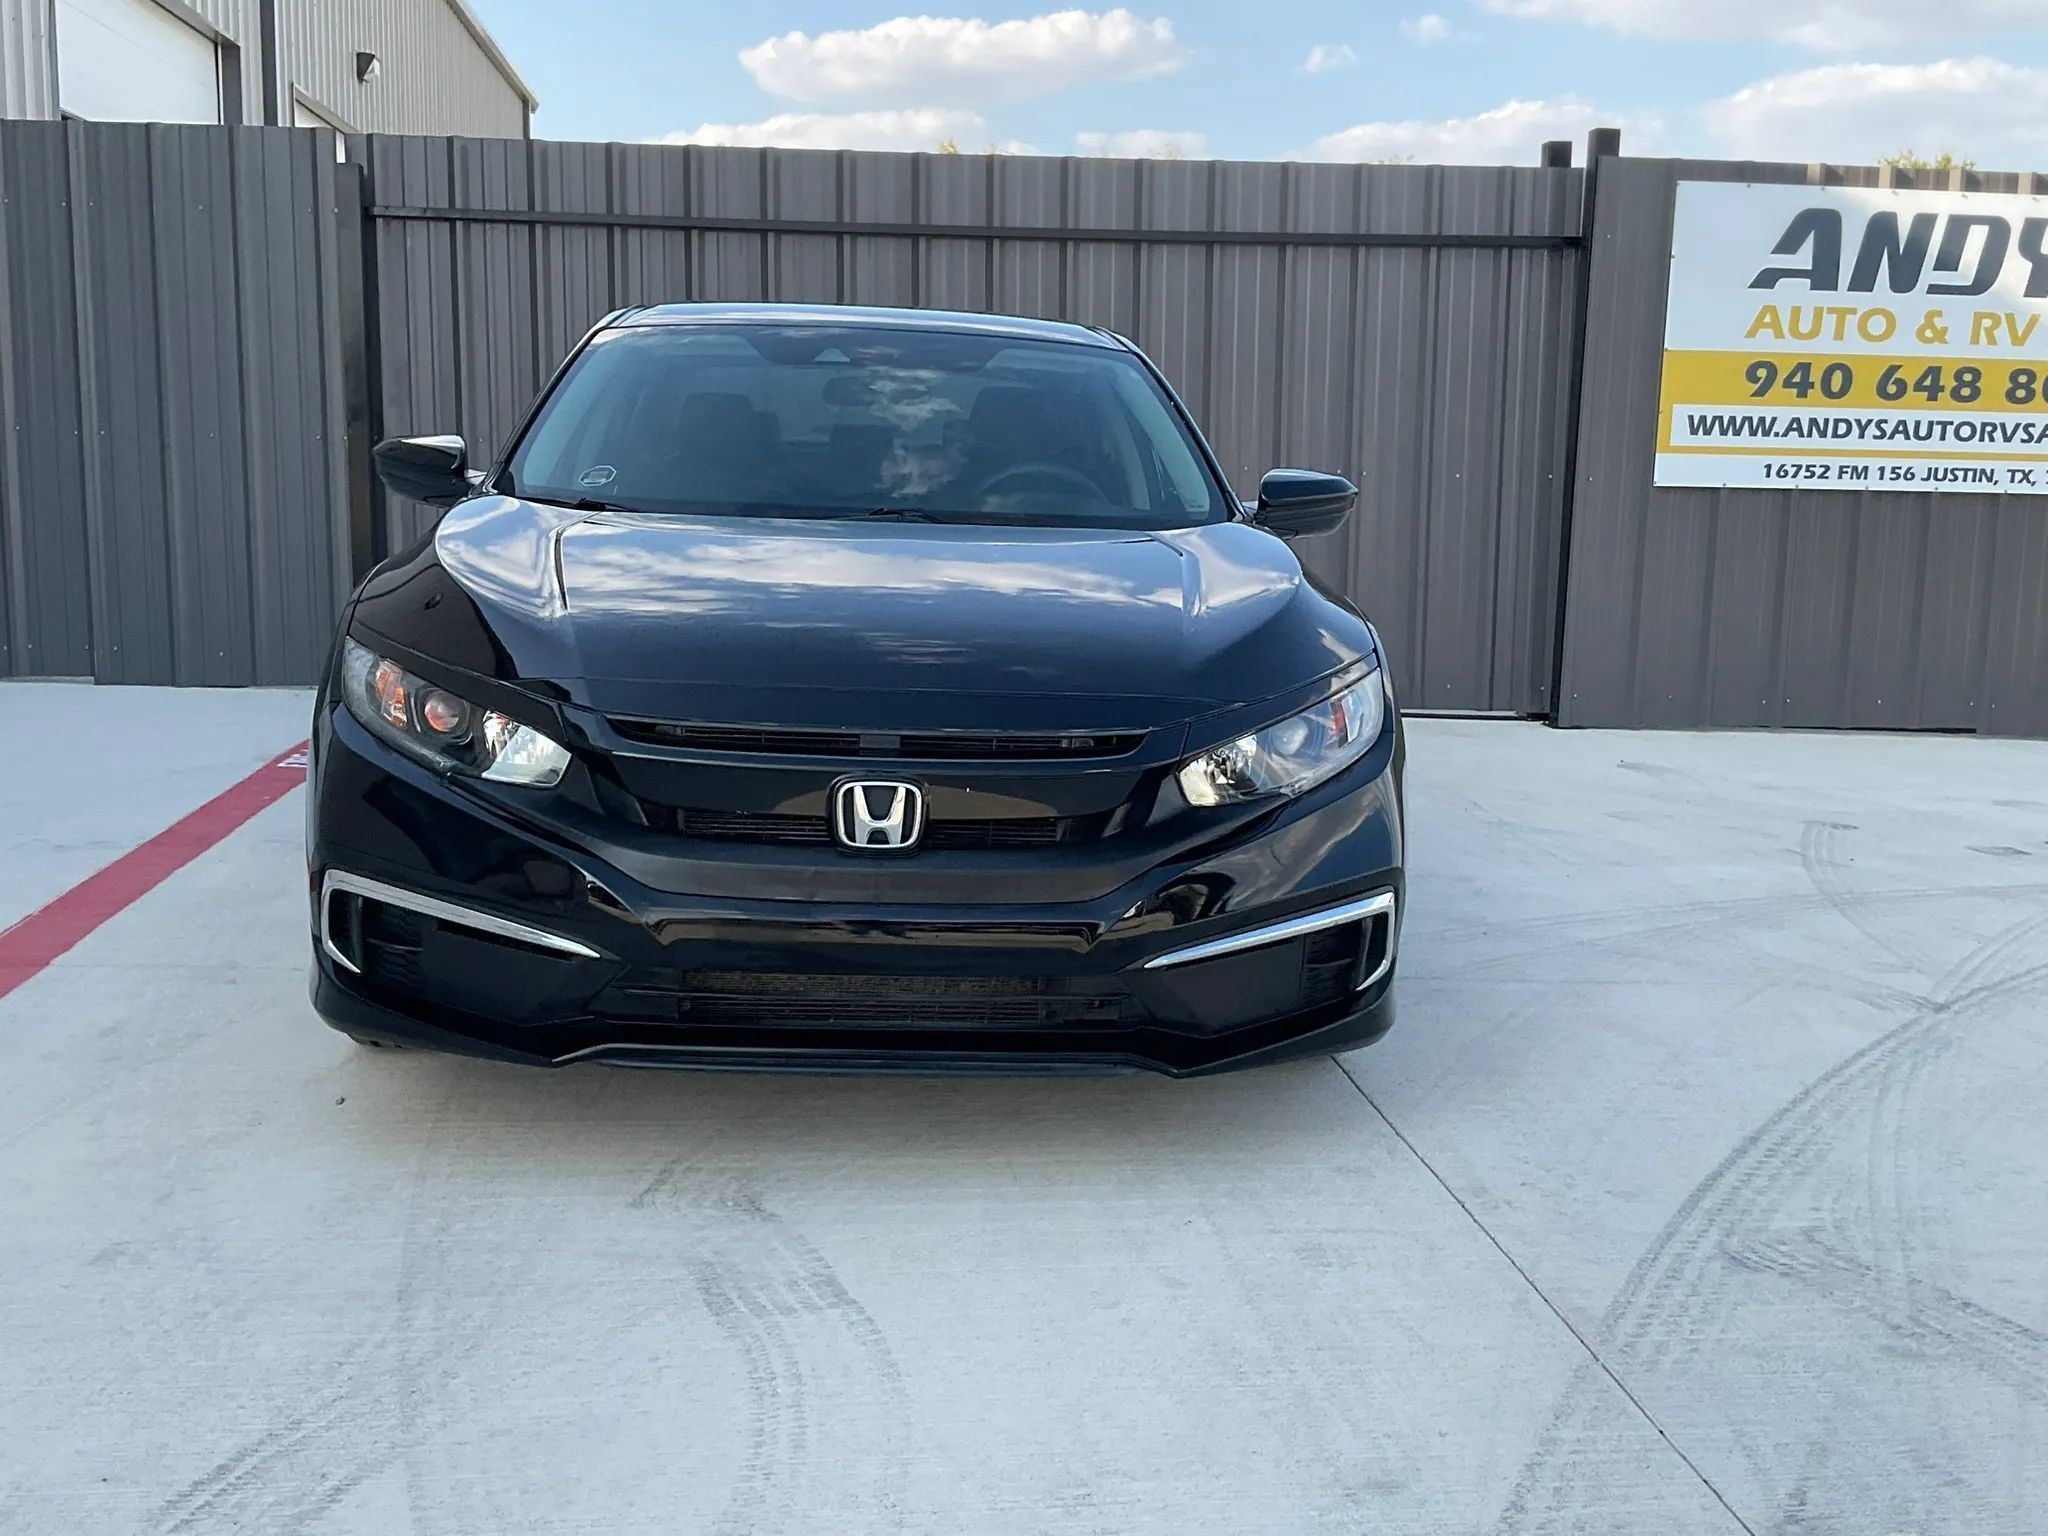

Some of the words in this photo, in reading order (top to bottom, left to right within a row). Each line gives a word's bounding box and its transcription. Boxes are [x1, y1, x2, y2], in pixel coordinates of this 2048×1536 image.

[1744, 305, 1897, 342] AUTO
[1915, 310, 1949, 345] &
[1970, 311, 2041, 346] RV
[1744, 360, 1853, 400] 940
[1875, 365, 1983, 404] 648
[2004, 368, 2048, 405] 8
[1763, 463, 1831, 480] 16752
[1837, 465, 1869, 481] FM
[1877, 465, 1916, 481] 156
[1920, 466, 1999, 486] JUSTIN,
[2006, 469, 2037, 487] TX,
